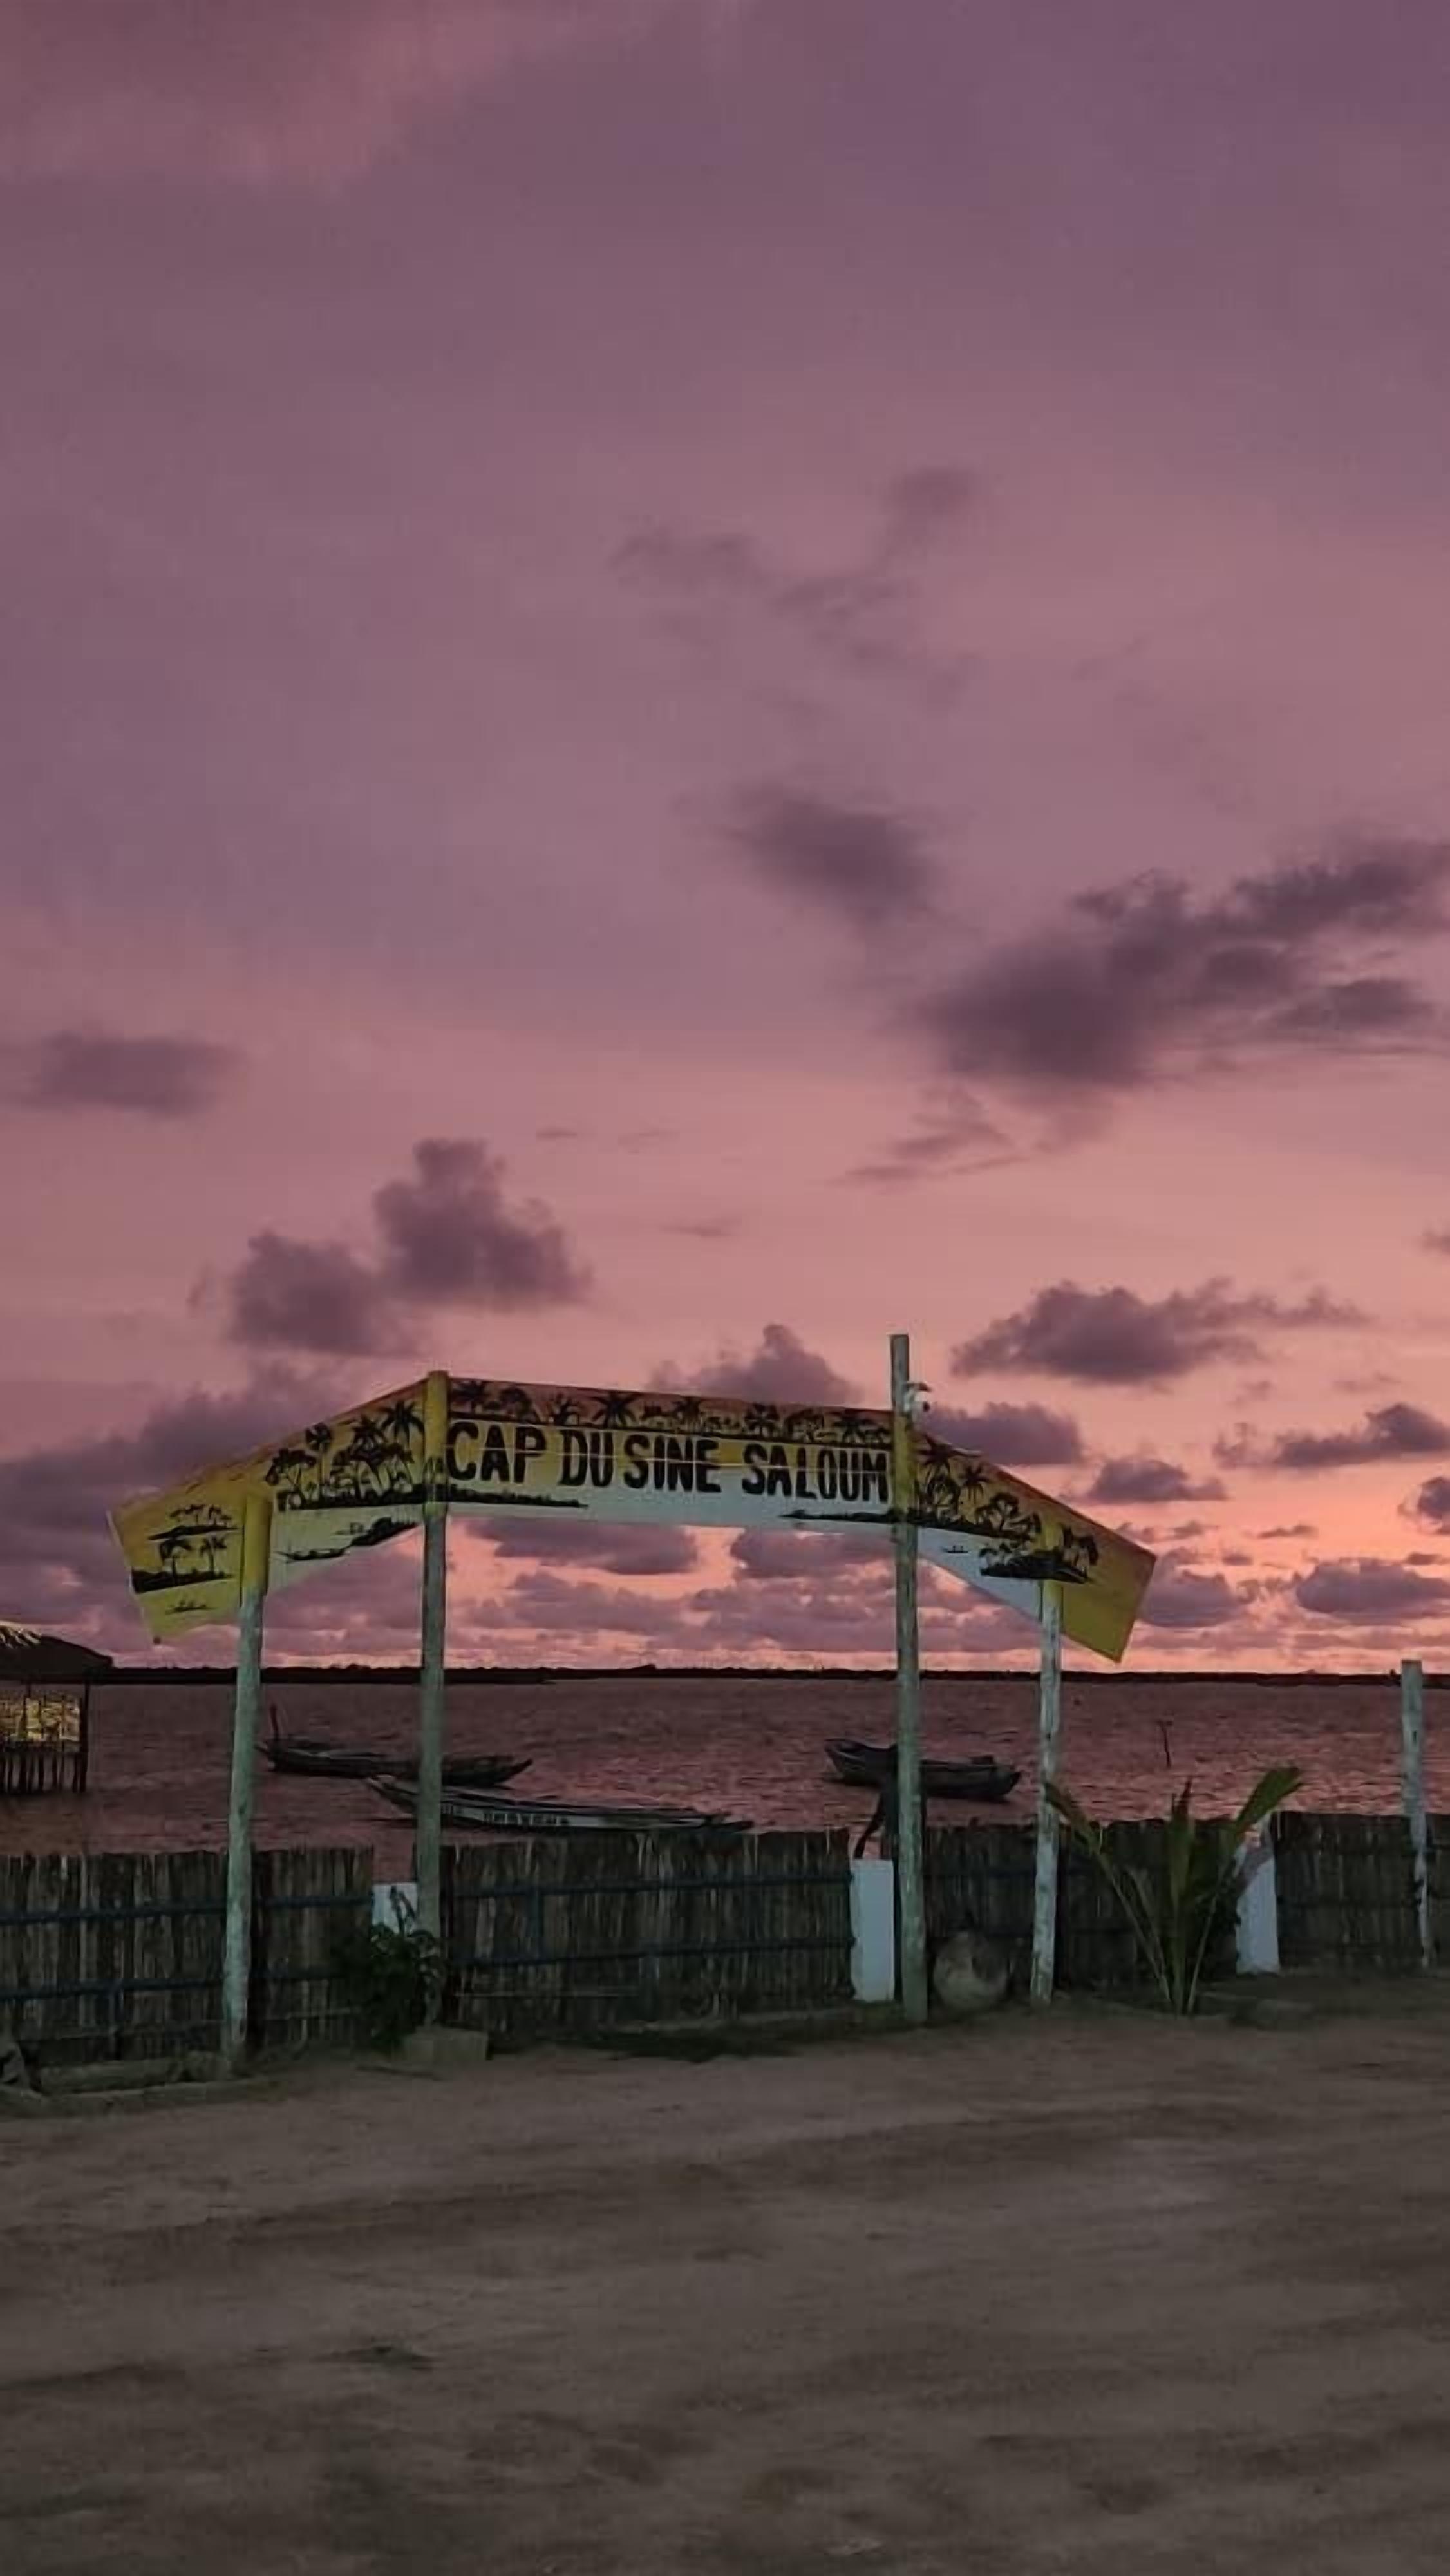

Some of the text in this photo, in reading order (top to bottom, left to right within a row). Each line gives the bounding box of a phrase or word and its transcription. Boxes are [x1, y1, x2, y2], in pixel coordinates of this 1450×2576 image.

[446, 1422, 889, 1503] CAP DU SINE SALOUM
